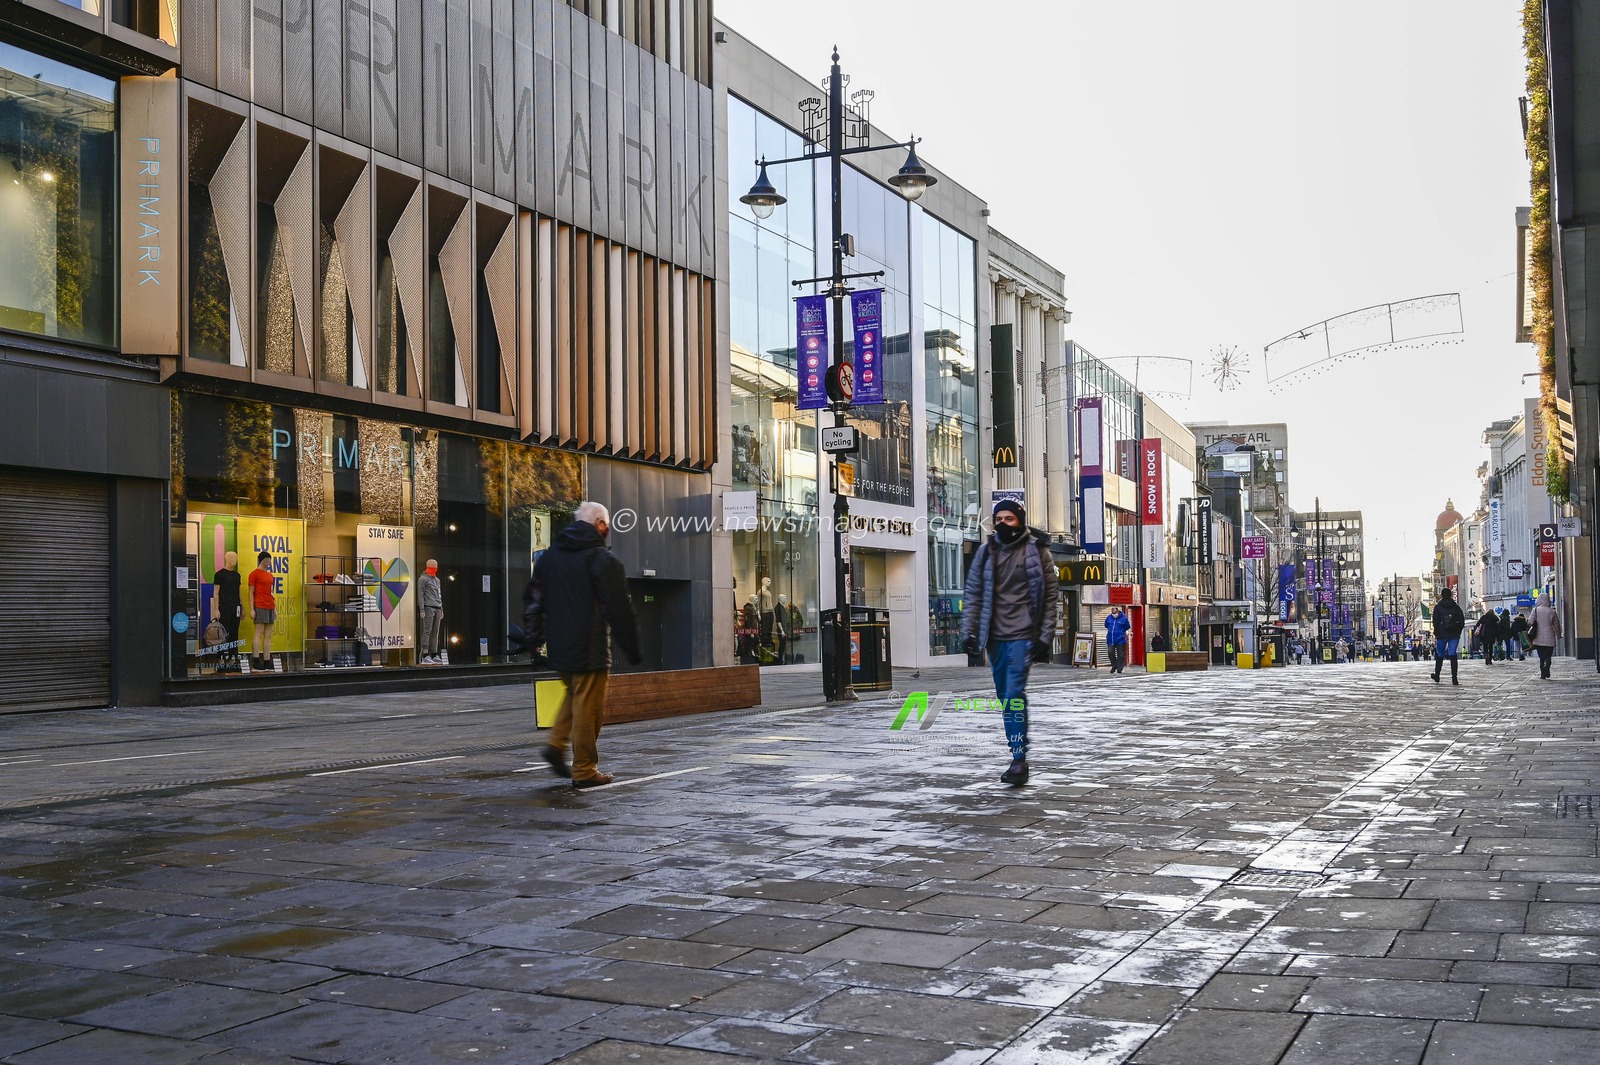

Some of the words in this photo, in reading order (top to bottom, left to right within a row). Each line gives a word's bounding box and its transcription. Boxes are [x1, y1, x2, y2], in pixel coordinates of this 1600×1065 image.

[138, 137, 161, 286] PRIMARK
[1531, 408, 1545, 450] Square
[272, 428, 428, 477] PRIMARK
[825, 439, 852, 448] cycling
[1147, 449, 1156, 477] ROCK
[1531, 452, 1545, 486] Eldon
[862, 479, 875, 491] FOR
[876, 481, 887, 493] THE
[888, 484, 910, 497] PEOPLE
[1148, 484, 1156, 515] SNOW
[1199, 499, 1211, 508] JD
[368, 528, 386, 539] STAY
[387, 529, 404, 540] SAFE
[1491, 510, 1499, 541] BARCLAYS
[253, 534, 293, 554] LOYAL
[257, 556, 290, 574] ANS
[1466, 524, 1479, 599] Fenwick
[219, 642, 229, 651] SHOP
[229, 641, 234, 649] IN
[234, 638, 247, 648] STORE
[369, 636, 386, 647] STAY
[387, 635, 405, 646] SAFE
